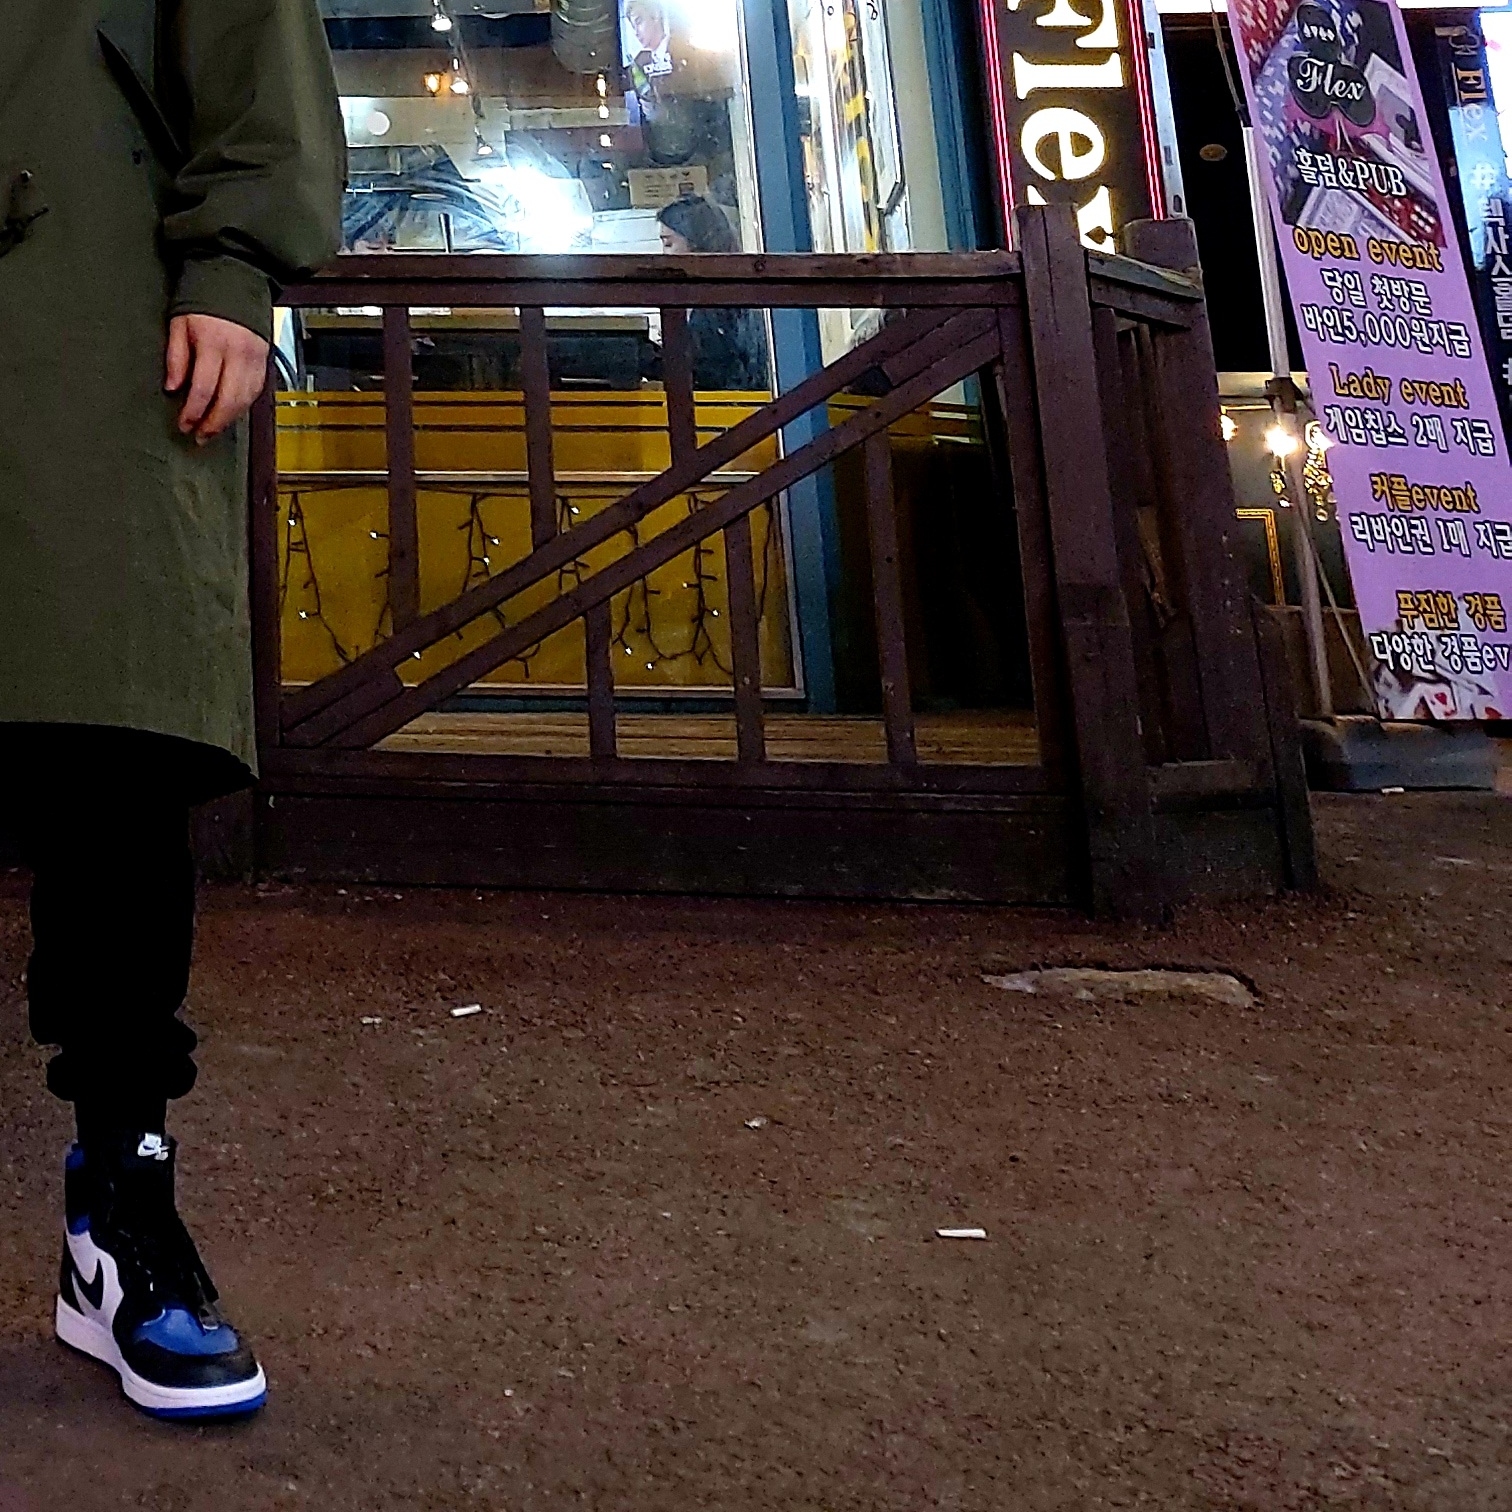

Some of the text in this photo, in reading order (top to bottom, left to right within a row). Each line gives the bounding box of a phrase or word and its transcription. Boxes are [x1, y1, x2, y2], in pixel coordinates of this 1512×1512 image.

[1296, 56, 1366, 102] Flex
[1294, 146, 1408, 197] 홀덤&PUB
[1293, 226, 1444, 273] open event
[1320, 267, 1433, 316] 당일 첫방문
[1328, 362, 1392, 405] Lady
[1400, 378, 1470, 410] event
[1324, 405, 1496, 456] 게임칩스 2배 지급
[1369, 472, 1481, 513] 커플event
[1349, 511, 1436, 555] 리바인권
[1436, 517, 1472, 557] 1매
[1396, 589, 1507, 632] 푸짐한 경품
[1369, 631, 1437, 673] 다양한
